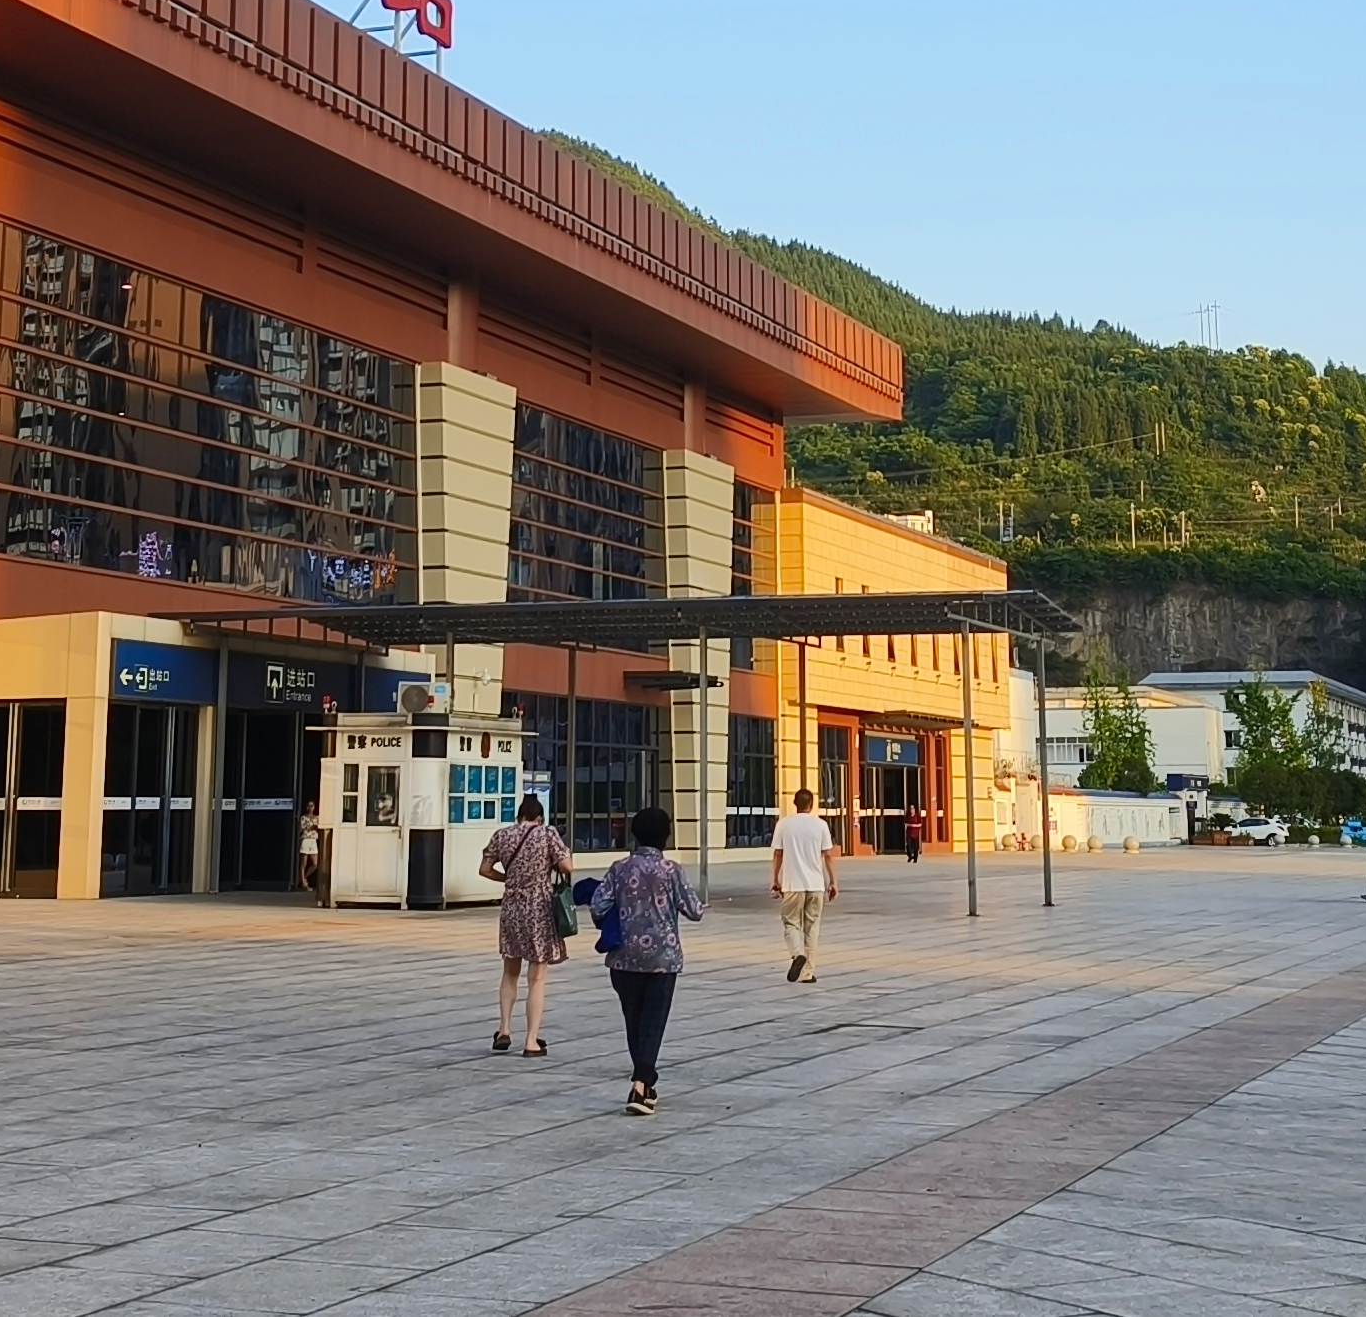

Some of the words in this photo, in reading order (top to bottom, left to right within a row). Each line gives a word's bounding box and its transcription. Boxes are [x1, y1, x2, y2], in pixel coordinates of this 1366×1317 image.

[286, 668, 316, 688] 进站口
[286, 689, 312, 702] Entrance
[347, 734, 367, 750] 警察
[371, 736, 402, 748] POLICE
[498, 739, 512, 753] POLICE
